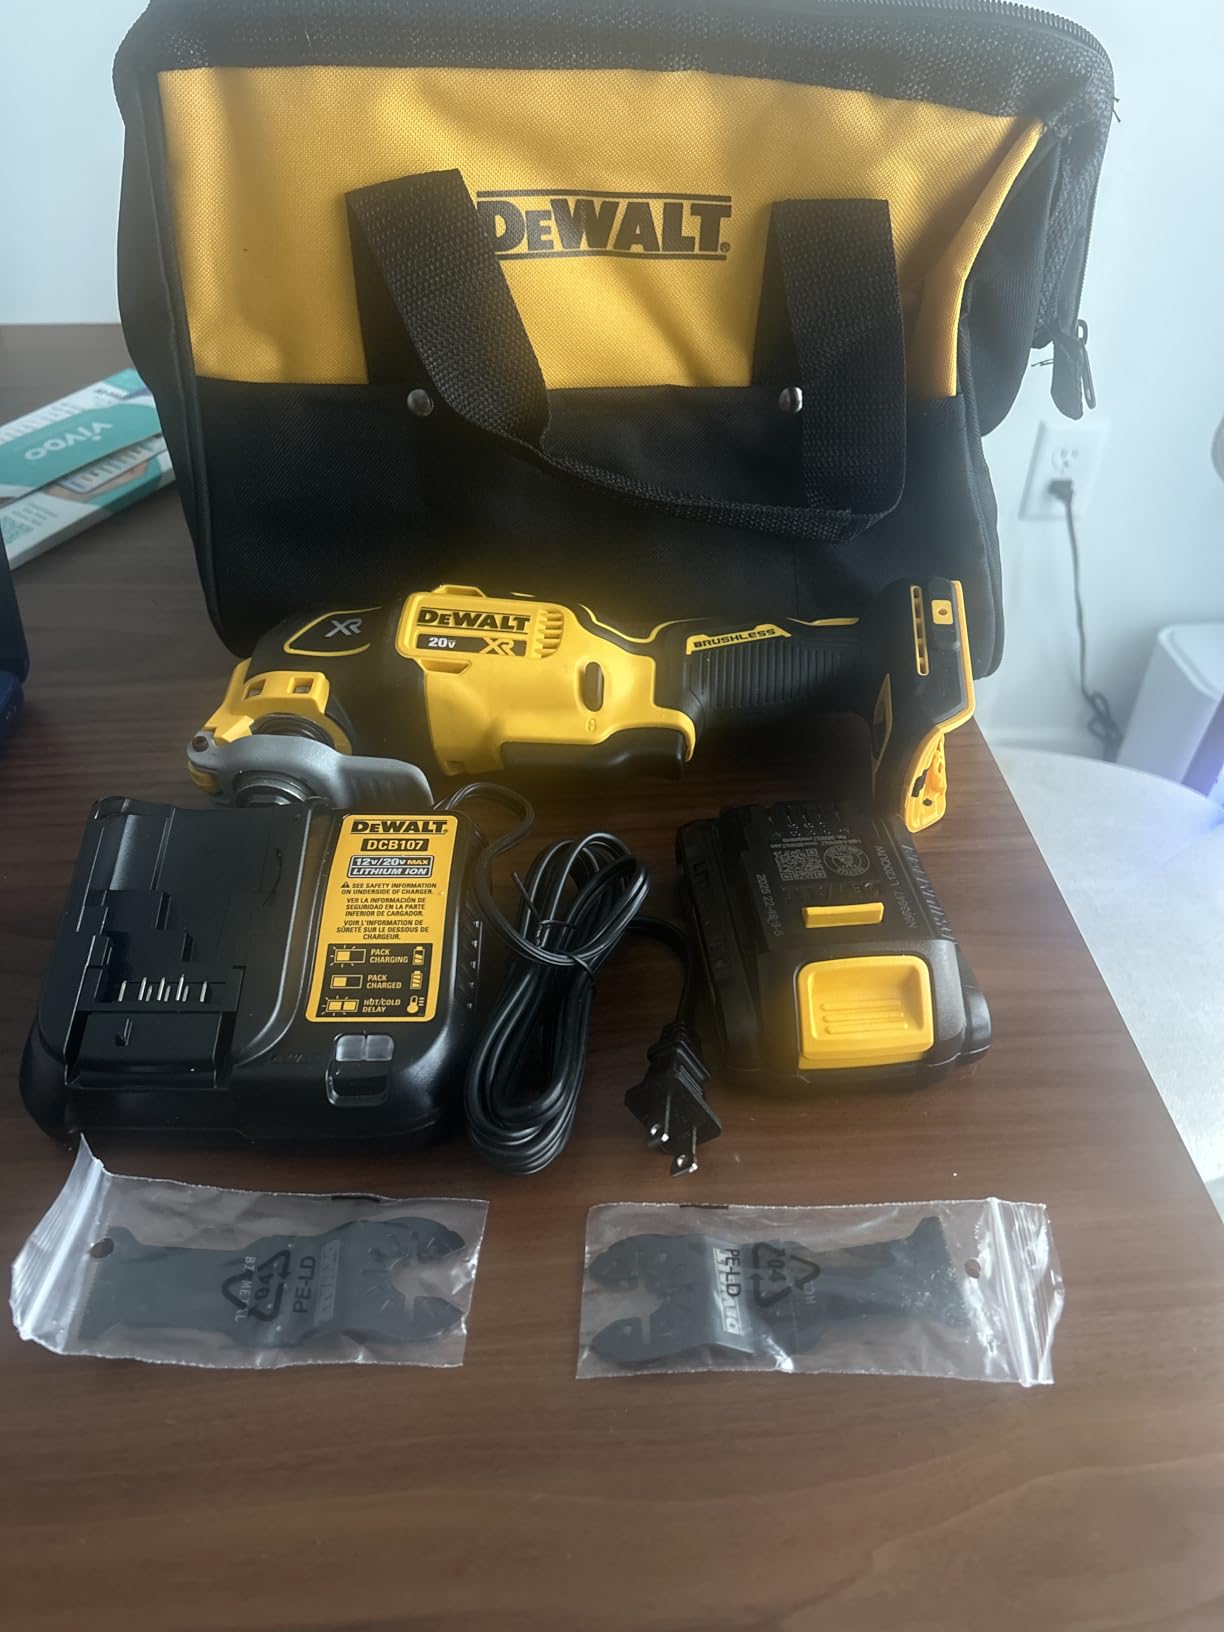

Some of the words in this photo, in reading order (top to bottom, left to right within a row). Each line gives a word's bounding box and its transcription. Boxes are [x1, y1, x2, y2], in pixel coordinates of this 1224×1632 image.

[324, 618, 363, 637] XR
[416, 609, 530, 632] DEWALT
[479, 637, 515, 656] XR
[693, 628, 776, 649] BRUSHLESS
[351, 821, 448, 833] DEWALT
[366, 840, 424, 850] DCB107
[725, 1249, 741, 1297] PE-LD
[292, 1255, 316, 1313] PE-LD
